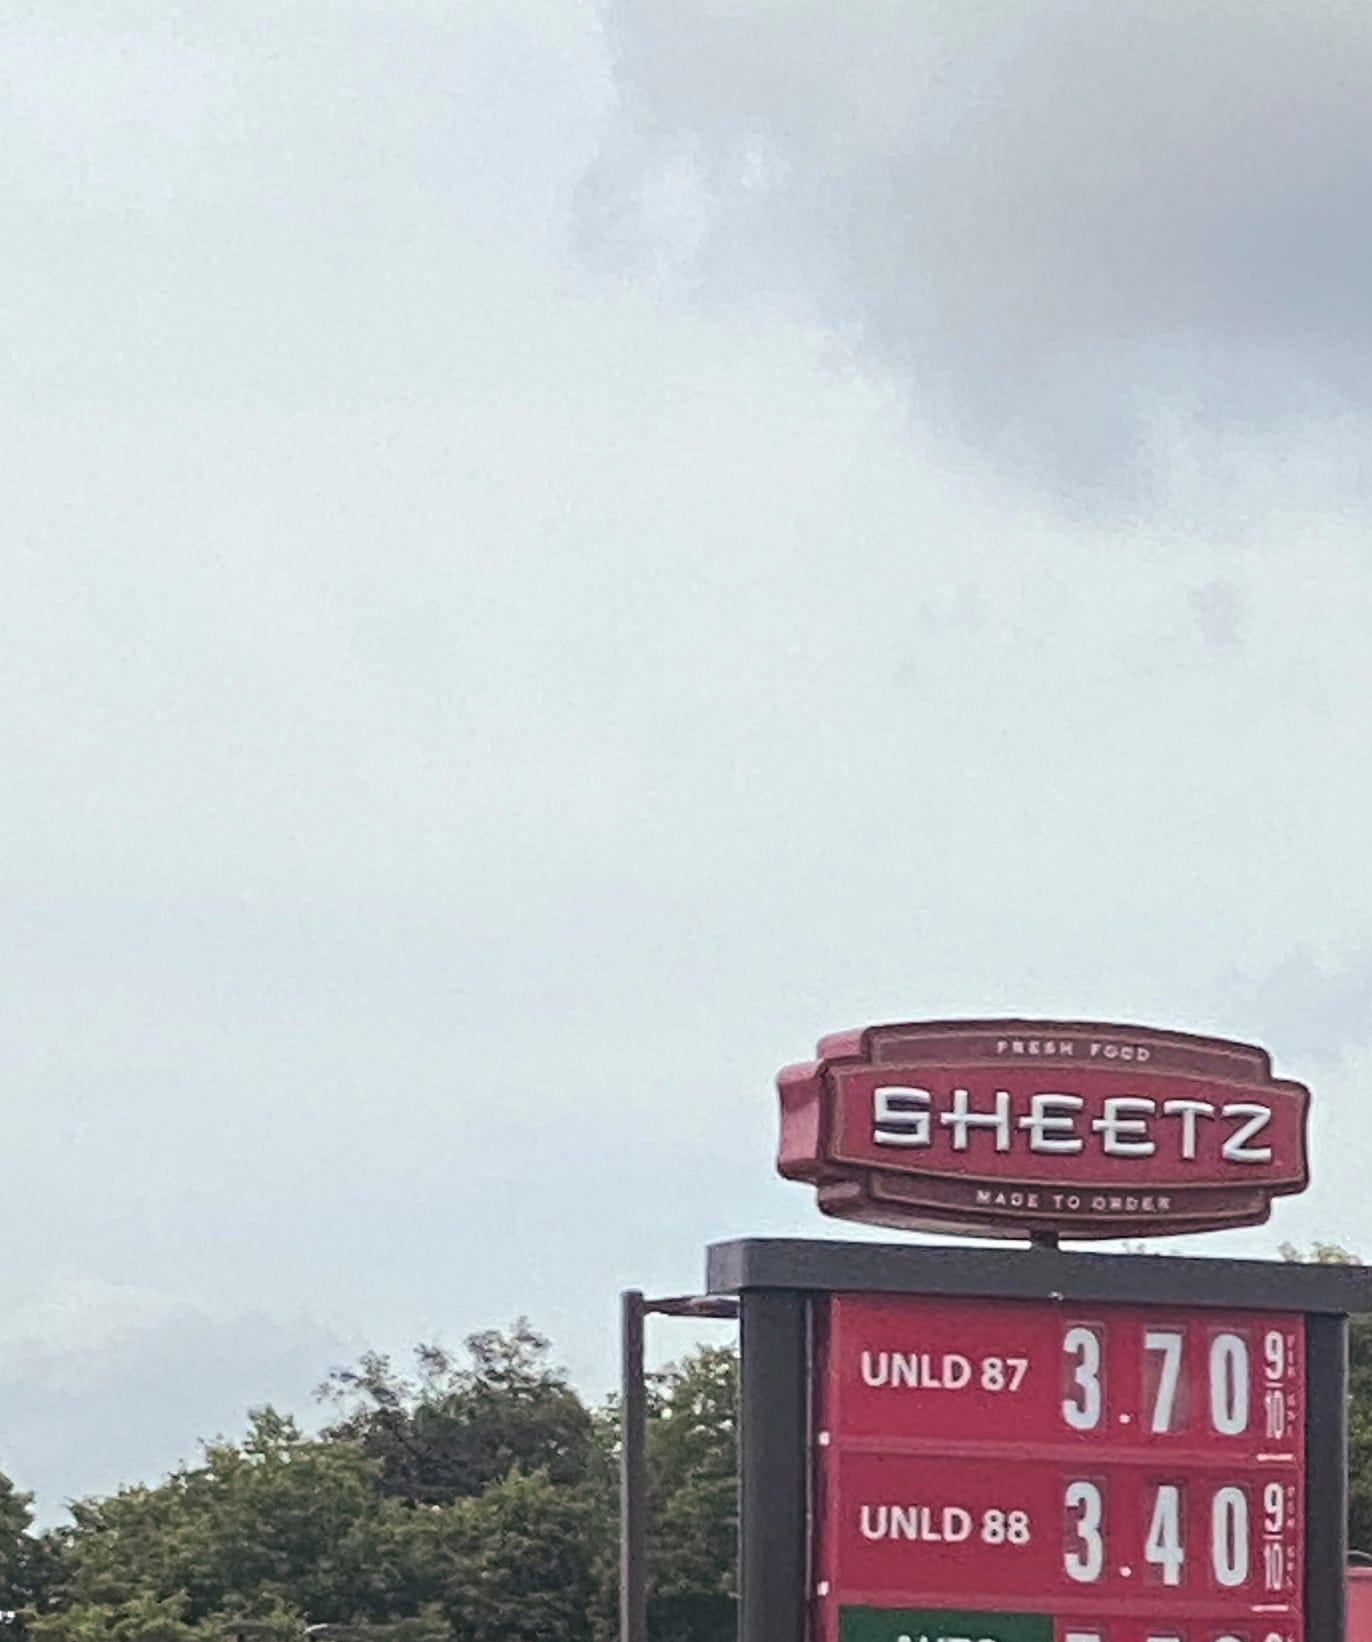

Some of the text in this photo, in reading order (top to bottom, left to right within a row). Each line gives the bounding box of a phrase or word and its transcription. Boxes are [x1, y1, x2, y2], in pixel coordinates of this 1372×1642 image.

[996, 1039, 1151, 1062] FRESH FOOD
[872, 1086, 1274, 1164] SHEETZ
[976, 1189, 1172, 1213] MADE TO ORDER
[861, 1351, 1030, 1392] UNLD 87
[859, 1505, 1031, 1545] UNLD 88
